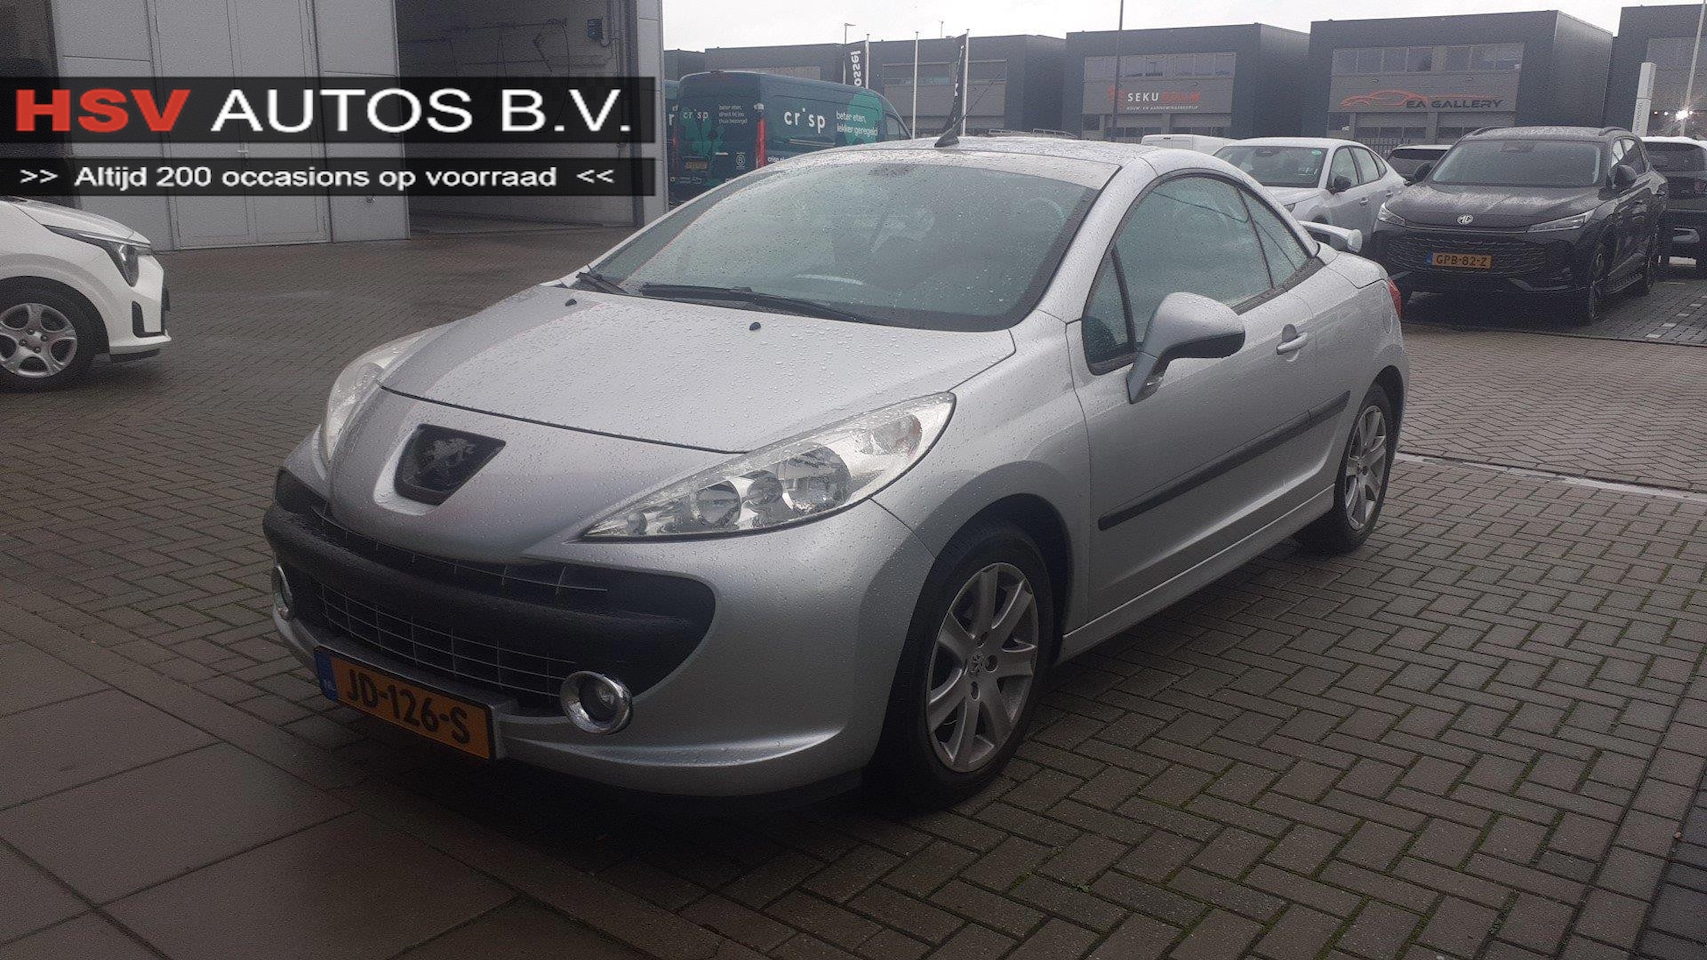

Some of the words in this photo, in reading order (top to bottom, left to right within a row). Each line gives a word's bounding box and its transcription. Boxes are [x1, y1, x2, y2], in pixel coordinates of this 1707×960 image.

[1127, 92, 1159, 102] SEKU
[1406, 100, 1426, 109] EA
[1431, 99, 1503, 109] GALLERY
[836, 111, 851, 121] beter
[837, 123, 854, 133] lekker
[854, 126, 879, 137] geregeld
[1436, 255, 1487, 266] GPB-82-Z
[347, 669, 470, 744] JD-126-S
